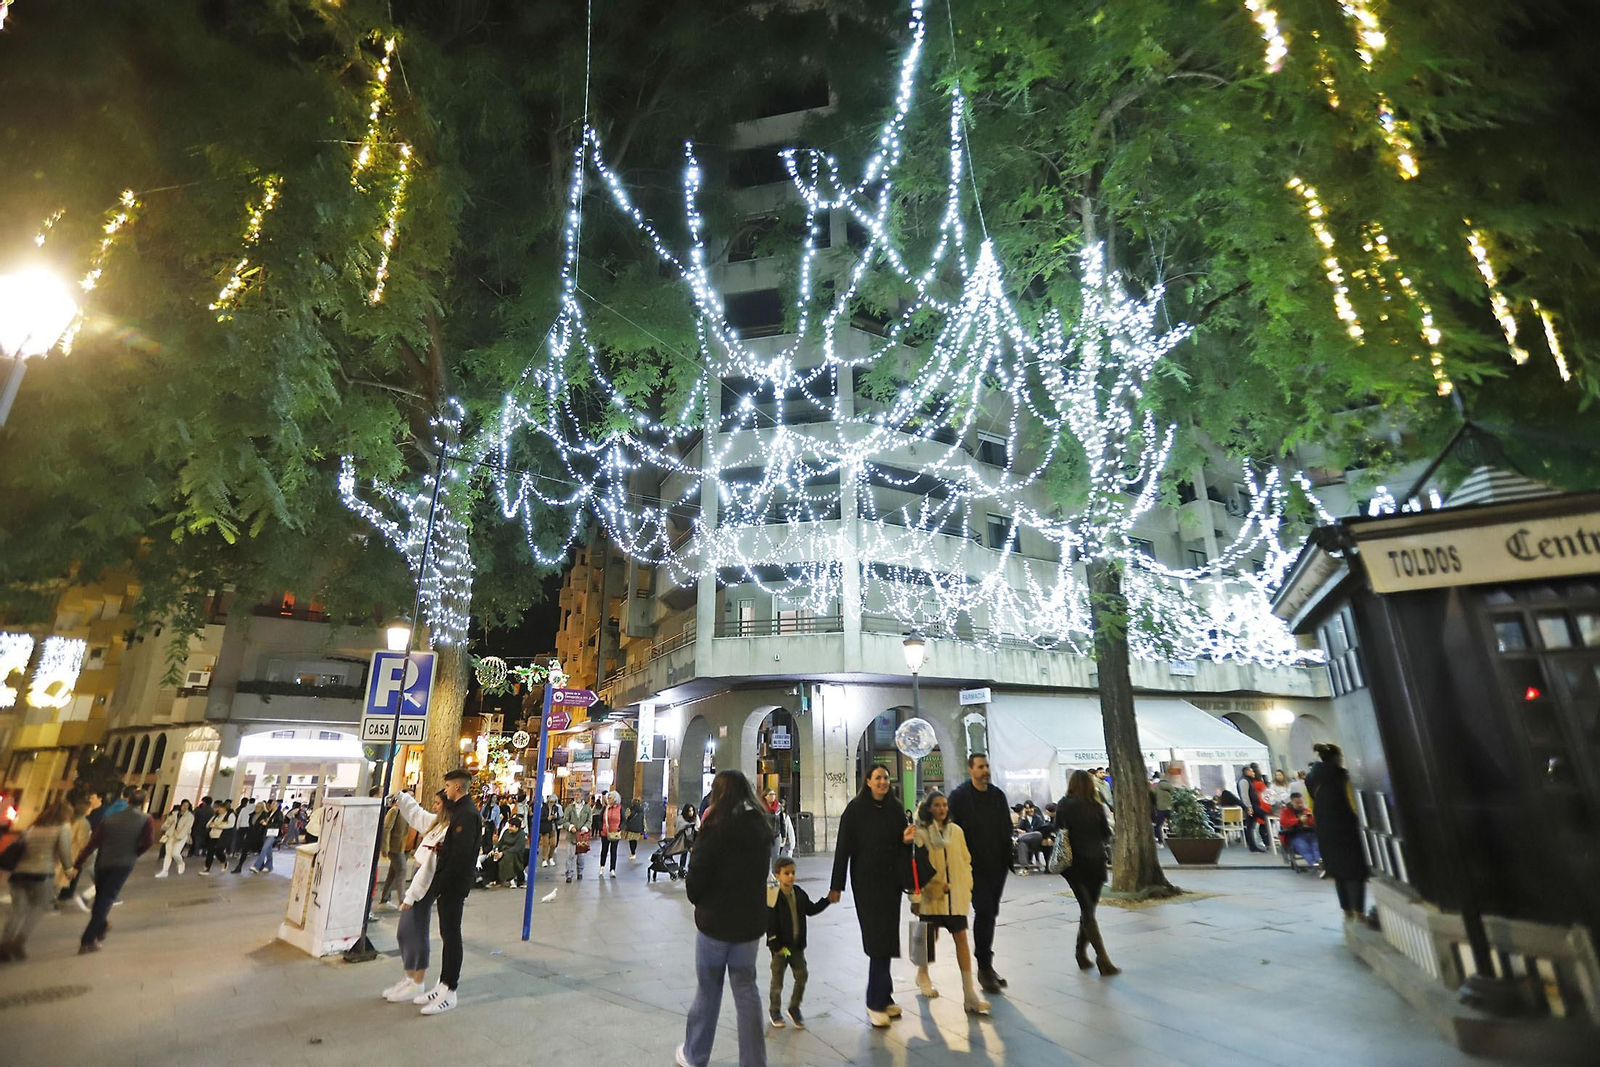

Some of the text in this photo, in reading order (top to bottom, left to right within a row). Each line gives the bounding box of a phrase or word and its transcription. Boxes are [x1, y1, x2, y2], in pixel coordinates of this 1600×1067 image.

[1388, 545, 1463, 579] TOLDOS
[374, 657, 419, 707] P
[368, 723, 419, 736] CASA OLON
[1074, 752, 1104, 761] FARMACIA
